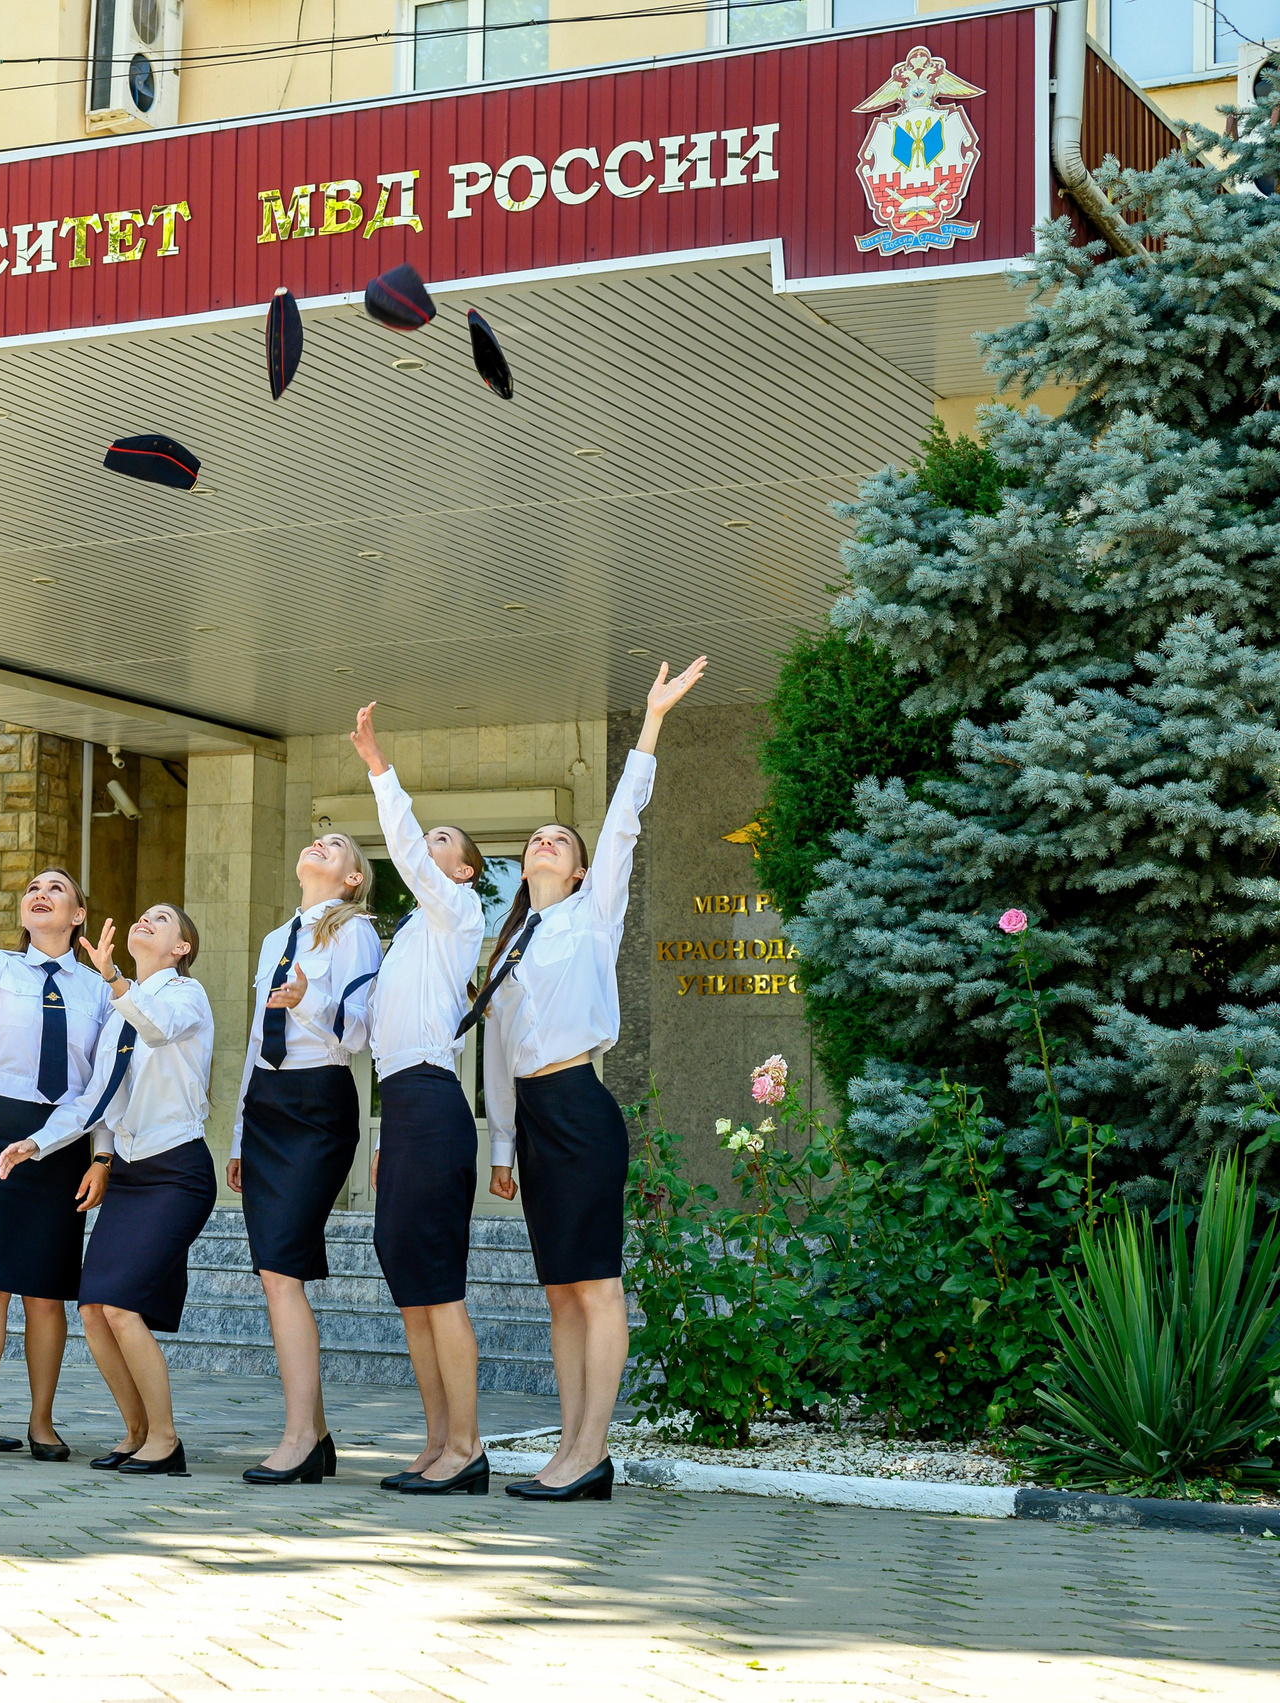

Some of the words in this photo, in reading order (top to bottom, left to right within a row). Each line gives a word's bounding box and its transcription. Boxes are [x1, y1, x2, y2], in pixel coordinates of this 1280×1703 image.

[257, 169, 424, 245] МВД
[447, 122, 780, 220] РОССИИ
[862, 233, 890, 247] СЛУЖИМ
[885, 236, 913, 250] РОССИИ
[944, 226, 971, 235] ЗАКОНУ
[693, 894, 749, 917] МВД
